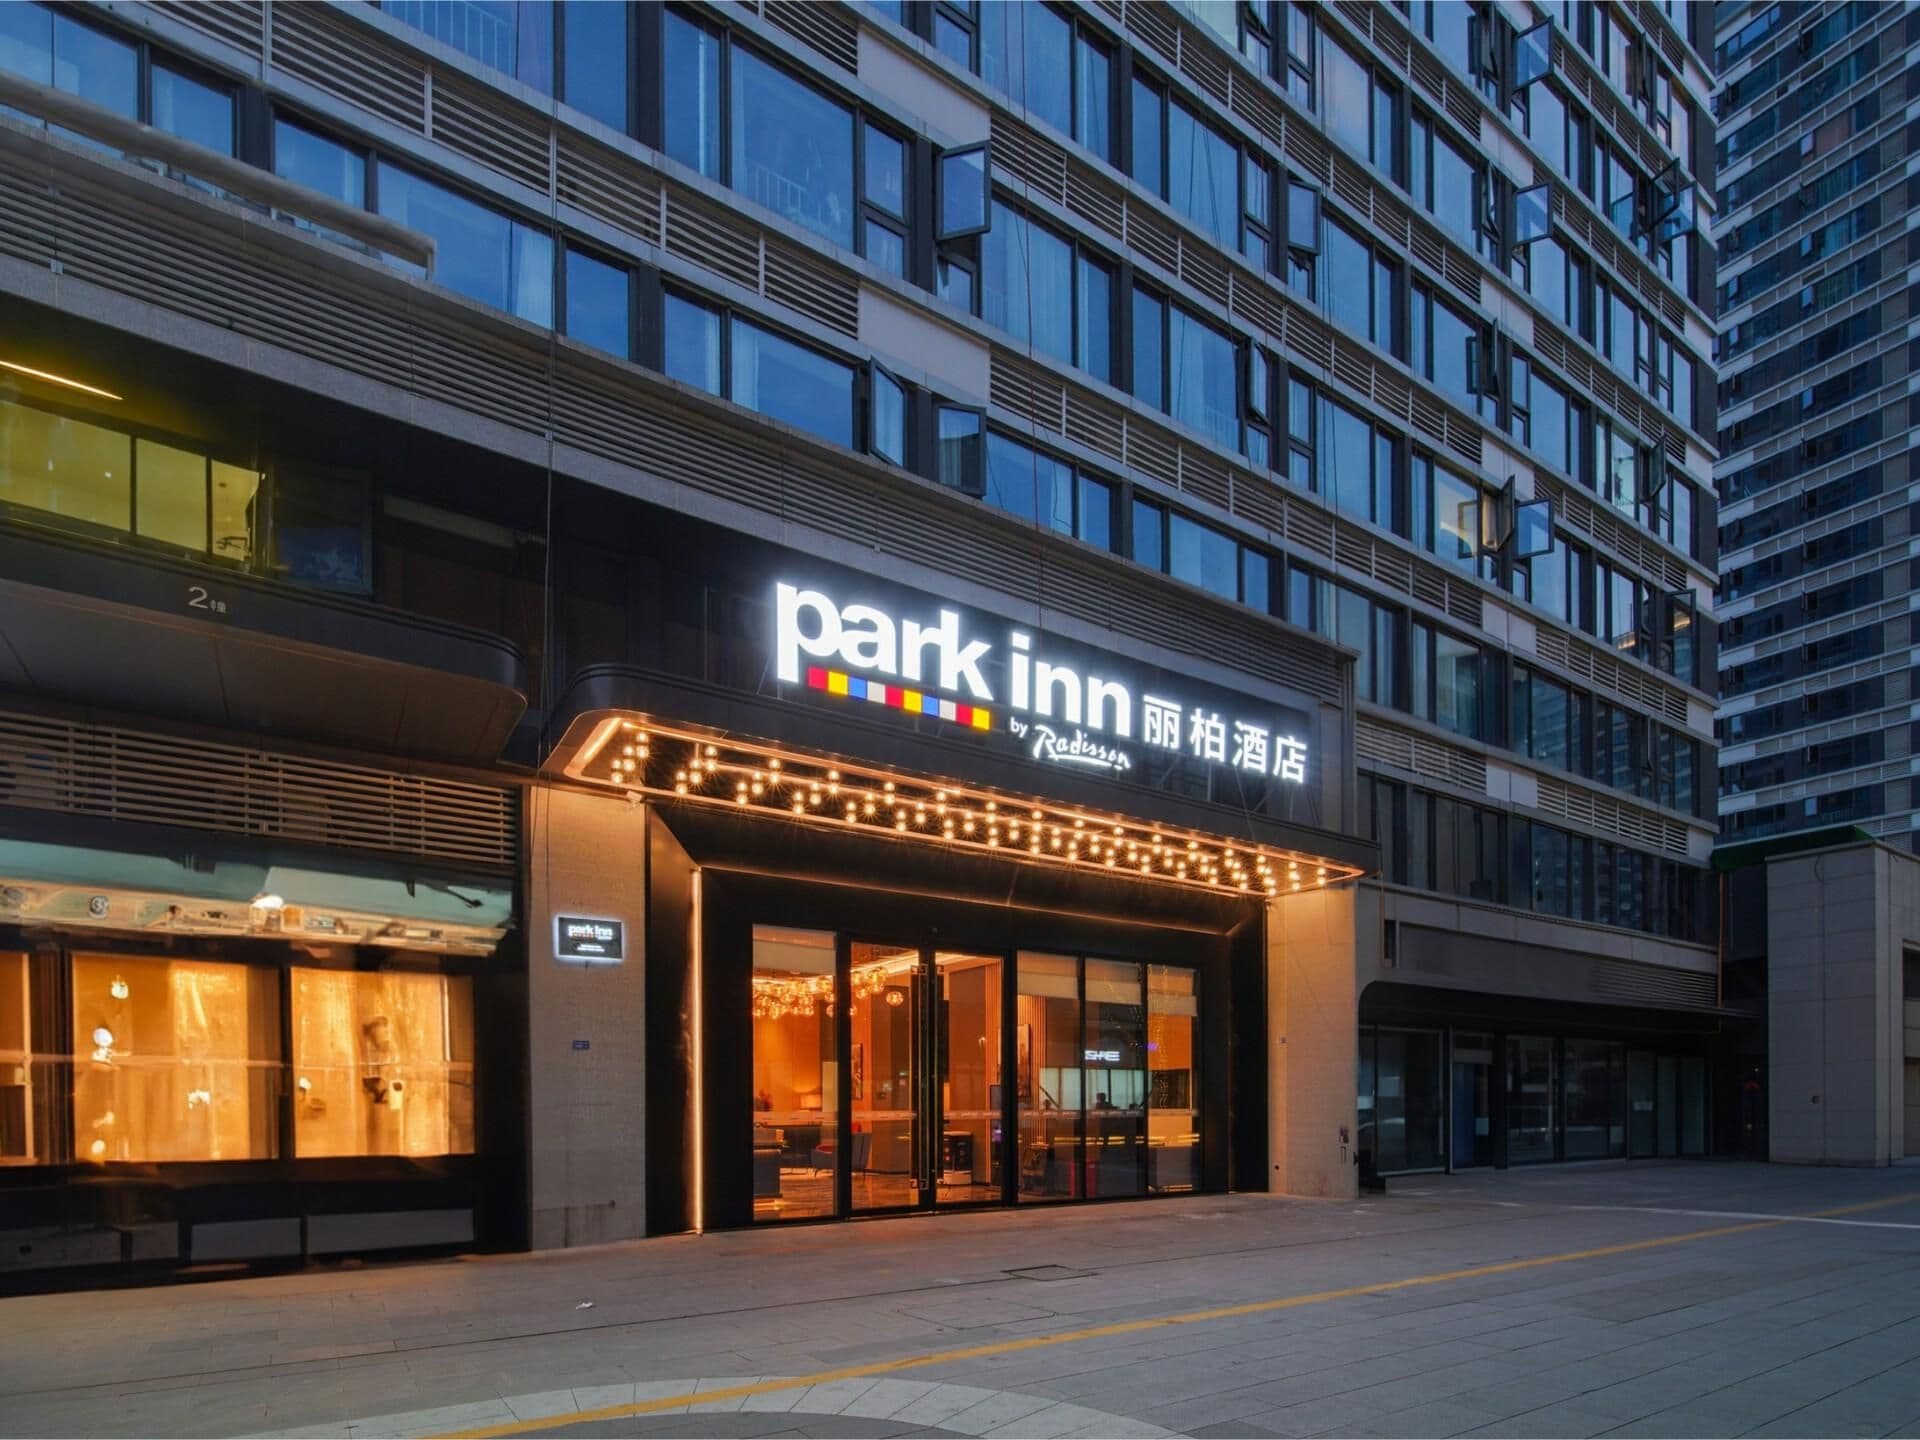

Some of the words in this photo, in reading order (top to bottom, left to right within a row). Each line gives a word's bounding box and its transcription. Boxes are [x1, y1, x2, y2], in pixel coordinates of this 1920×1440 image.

[776, 582, 994, 700] park
[1012, 632, 1131, 737] inn
[1010, 716, 1028, 738] by
[1033, 724, 1131, 768] Radisson
[1144, 694, 1307, 783] 丽柏酒店
[568, 925, 594, 937] park
